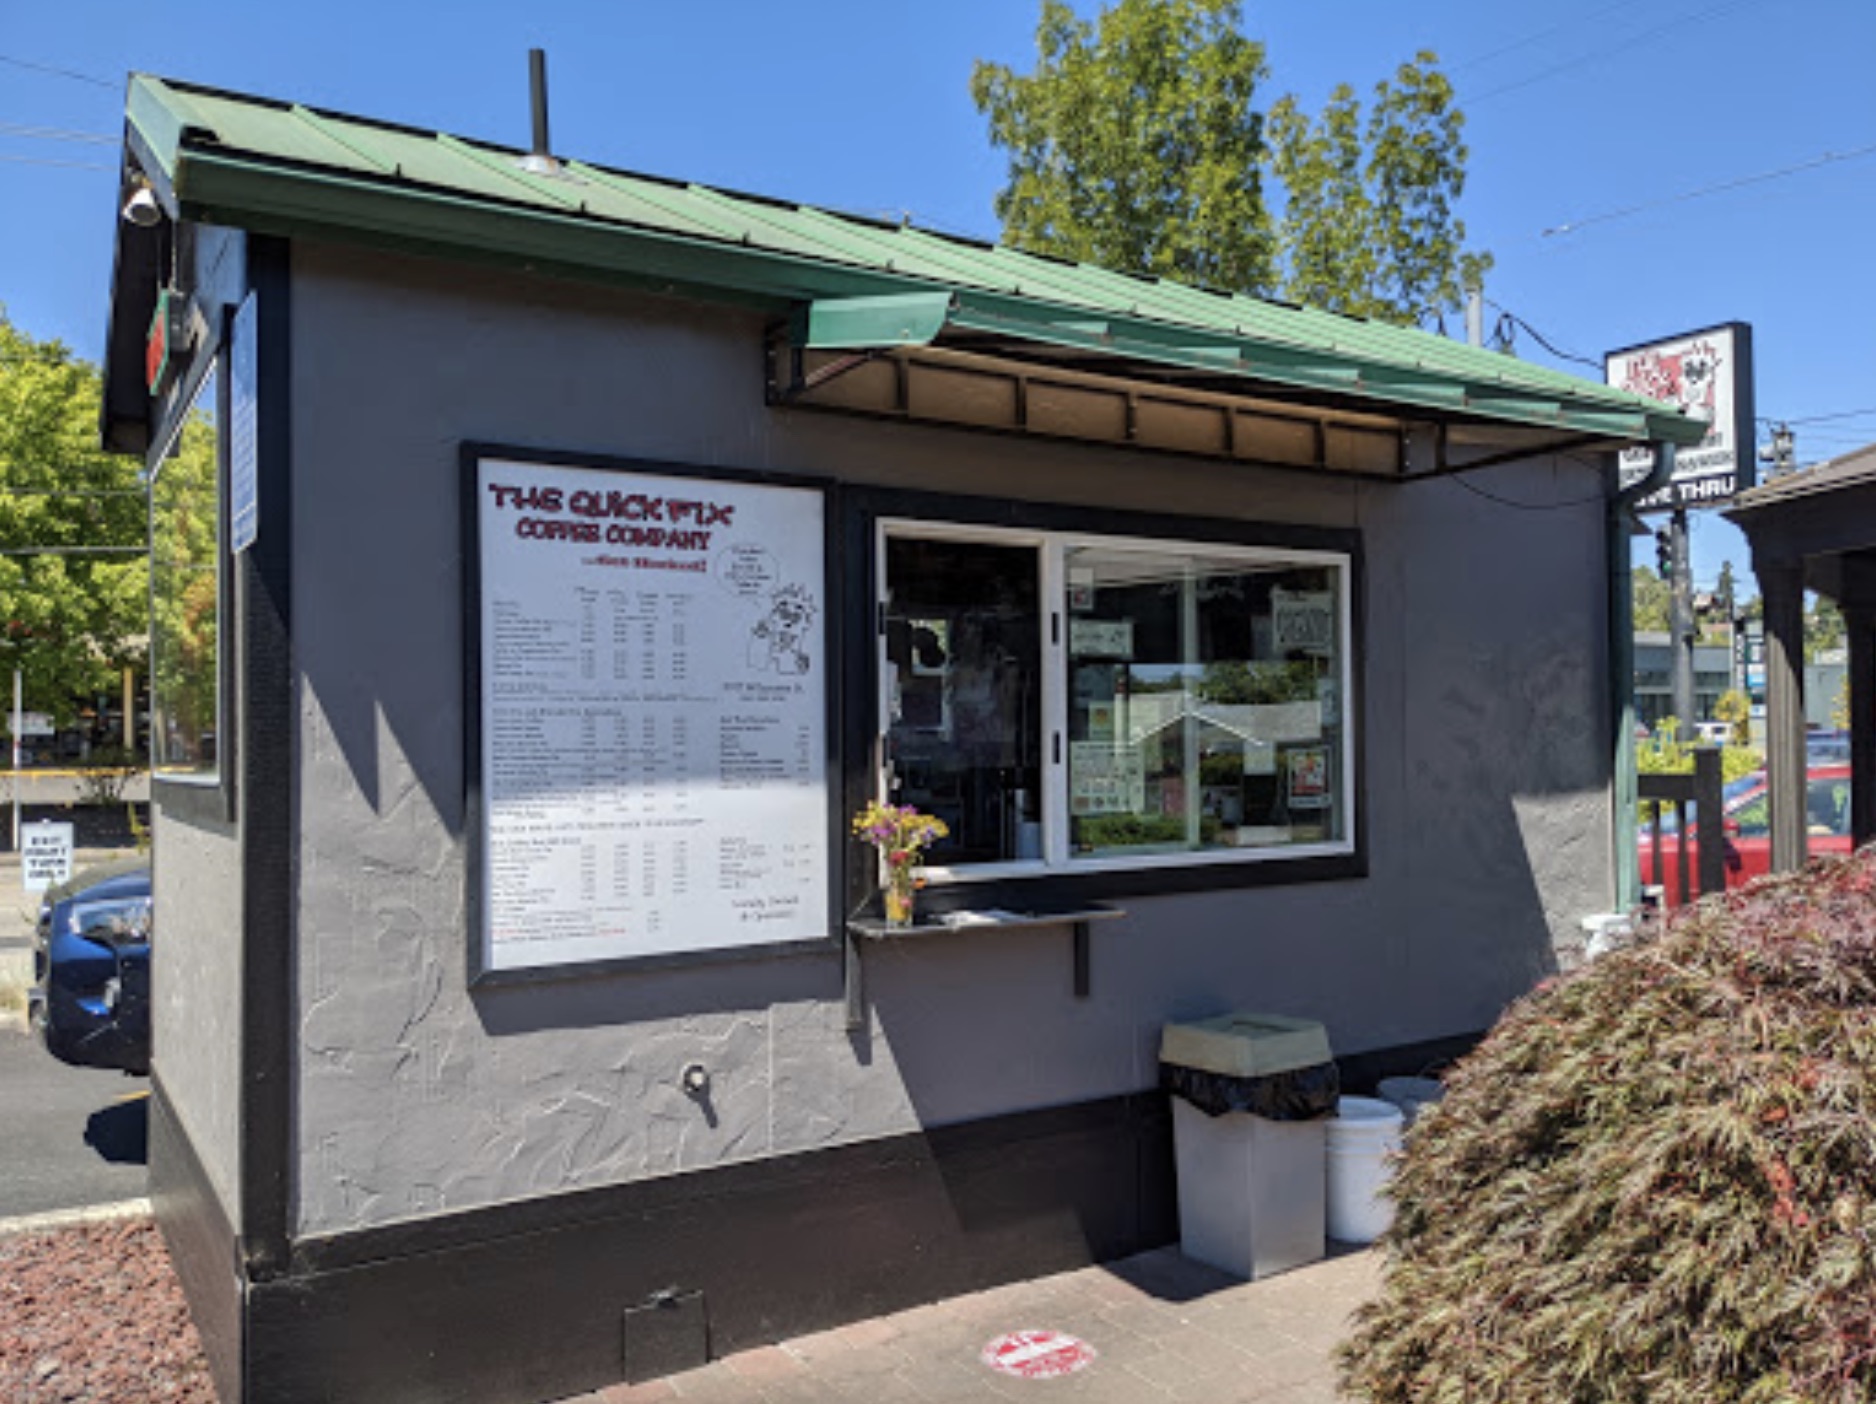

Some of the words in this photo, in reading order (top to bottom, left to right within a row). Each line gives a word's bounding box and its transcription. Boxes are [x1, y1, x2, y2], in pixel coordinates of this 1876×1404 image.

[488, 483, 564, 513] THE
[568, 489, 663, 521] QUICK
[666, 499, 735, 526] FIX
[1677, 475, 1734, 501] THRU
[516, 516, 601, 543] COFFEE
[606, 524, 712, 551] COMPANY
